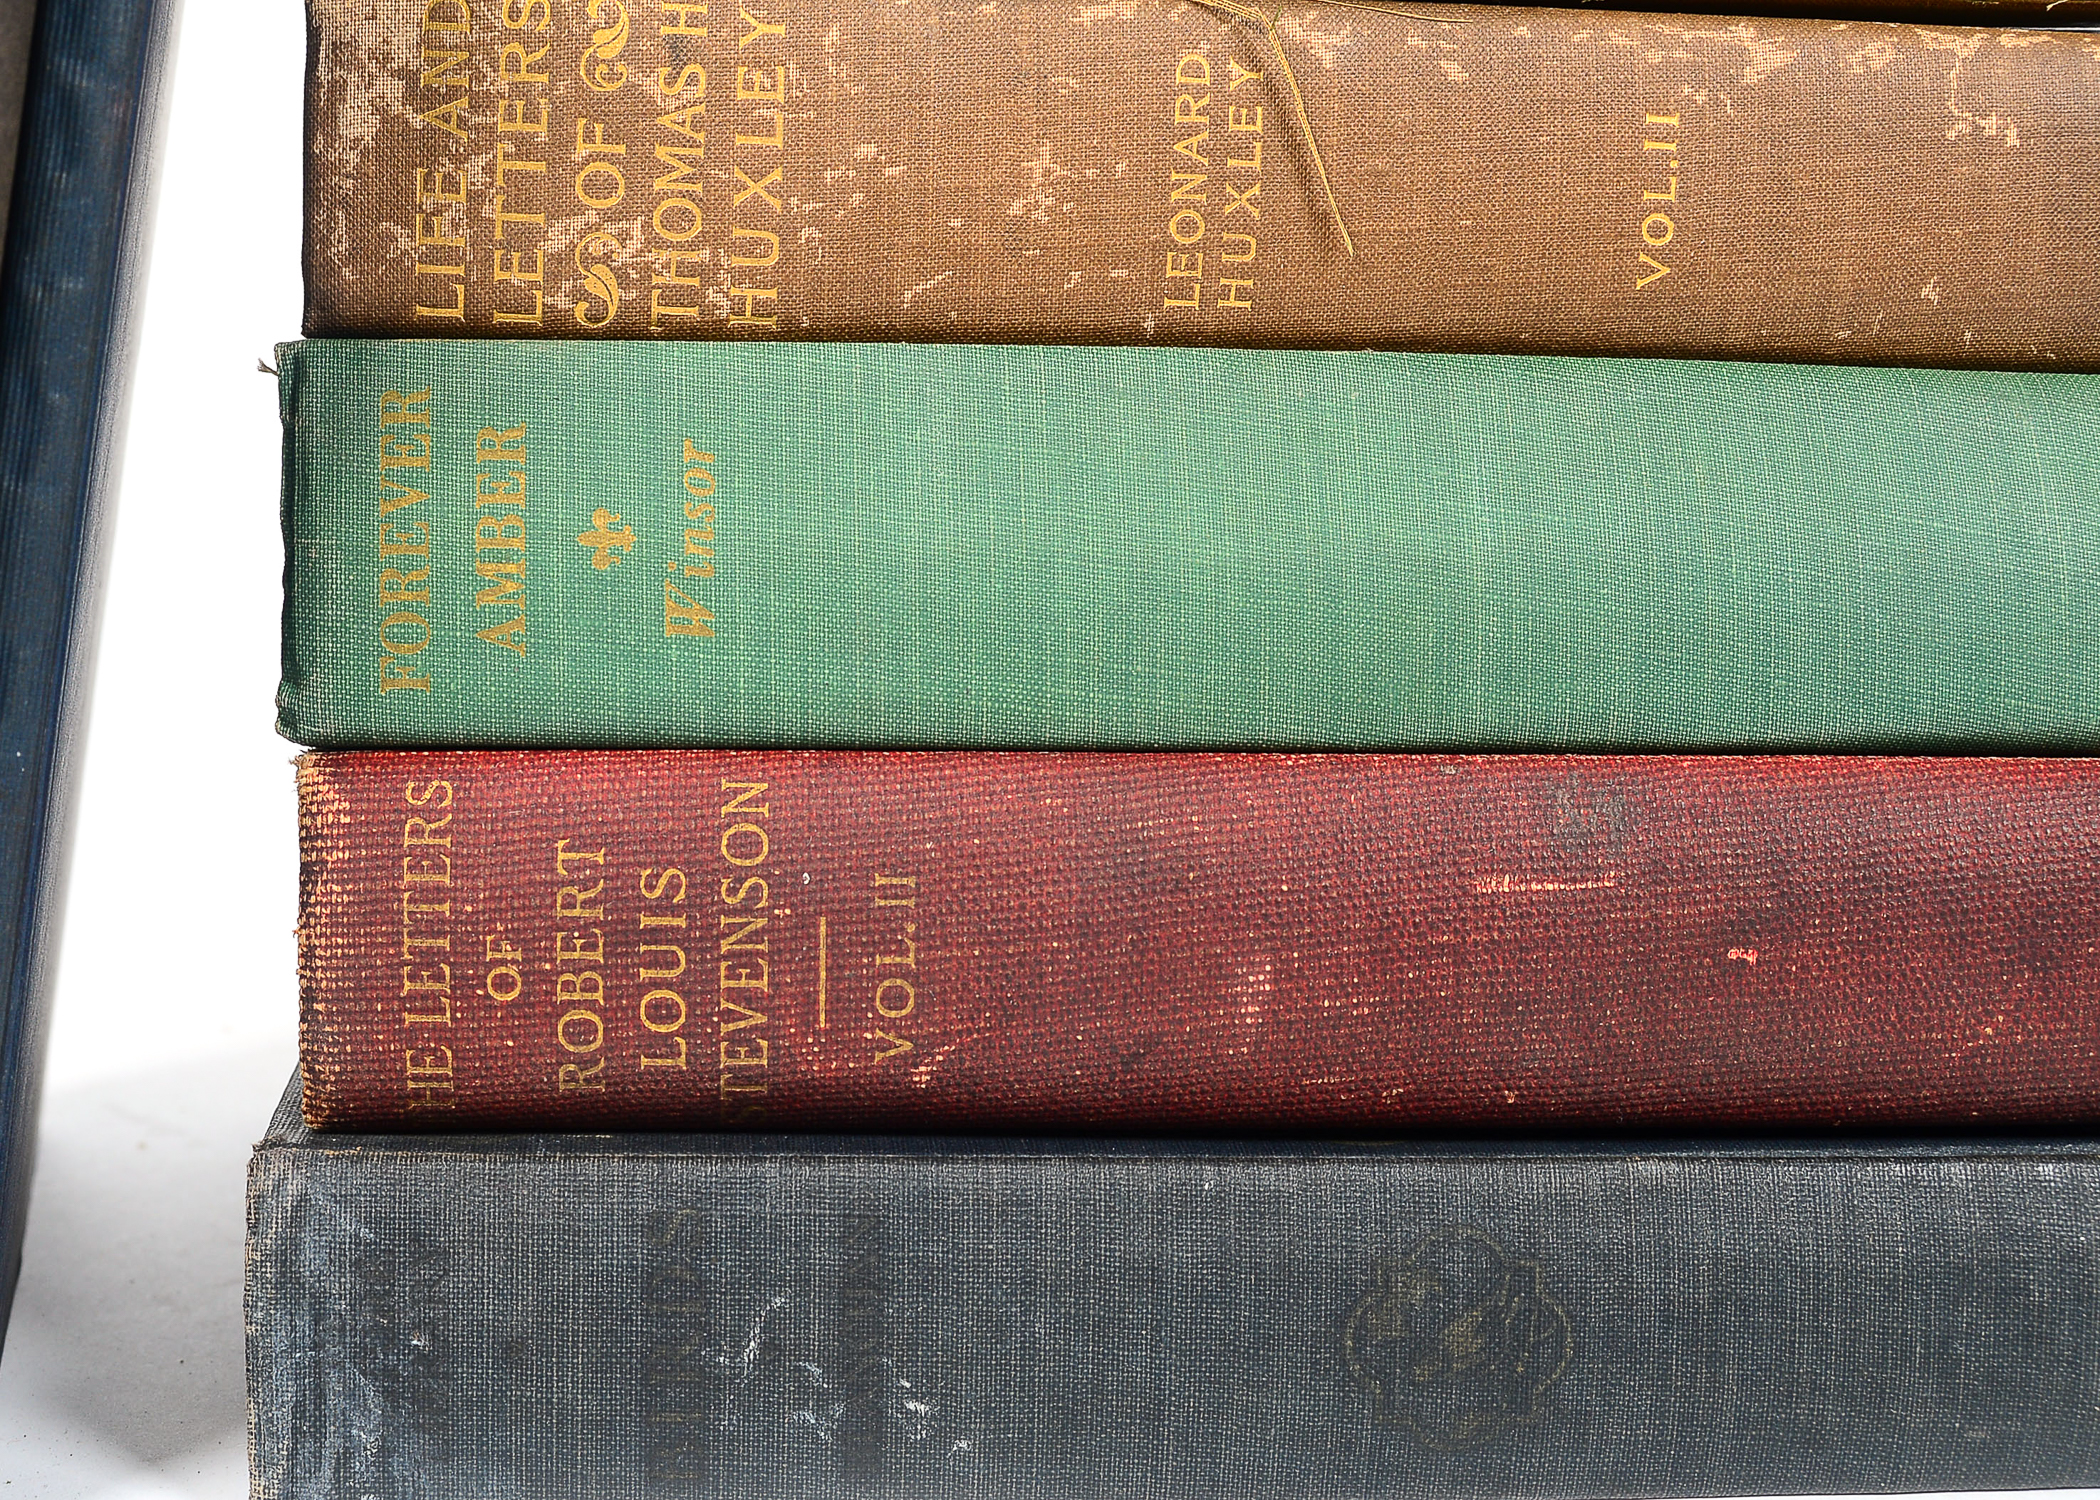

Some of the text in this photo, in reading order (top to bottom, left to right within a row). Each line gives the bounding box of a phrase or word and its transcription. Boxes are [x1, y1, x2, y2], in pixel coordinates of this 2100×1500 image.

[415, 0, 472, 323] LIFE AND
[493, 0, 551, 327] LETTERS
[575, 118, 627, 209] OF
[650, 63, 707, 330] THOMAS
[728, 7, 787, 330] HUXLEY
[1164, 53, 1212, 310] LEONARD
[1217, 56, 1265, 311] HUXLEY
[380, 386, 431, 695] FOREVER
[475, 421, 527, 657] AMBER
[665, 438, 716, 638] Winsor
[402, 779, 455, 1110] HE LETTERS
[486, 934, 522, 1001] OF
[556, 838, 605, 1093] ROBERT
[640, 867, 687, 1070] LOUIS
